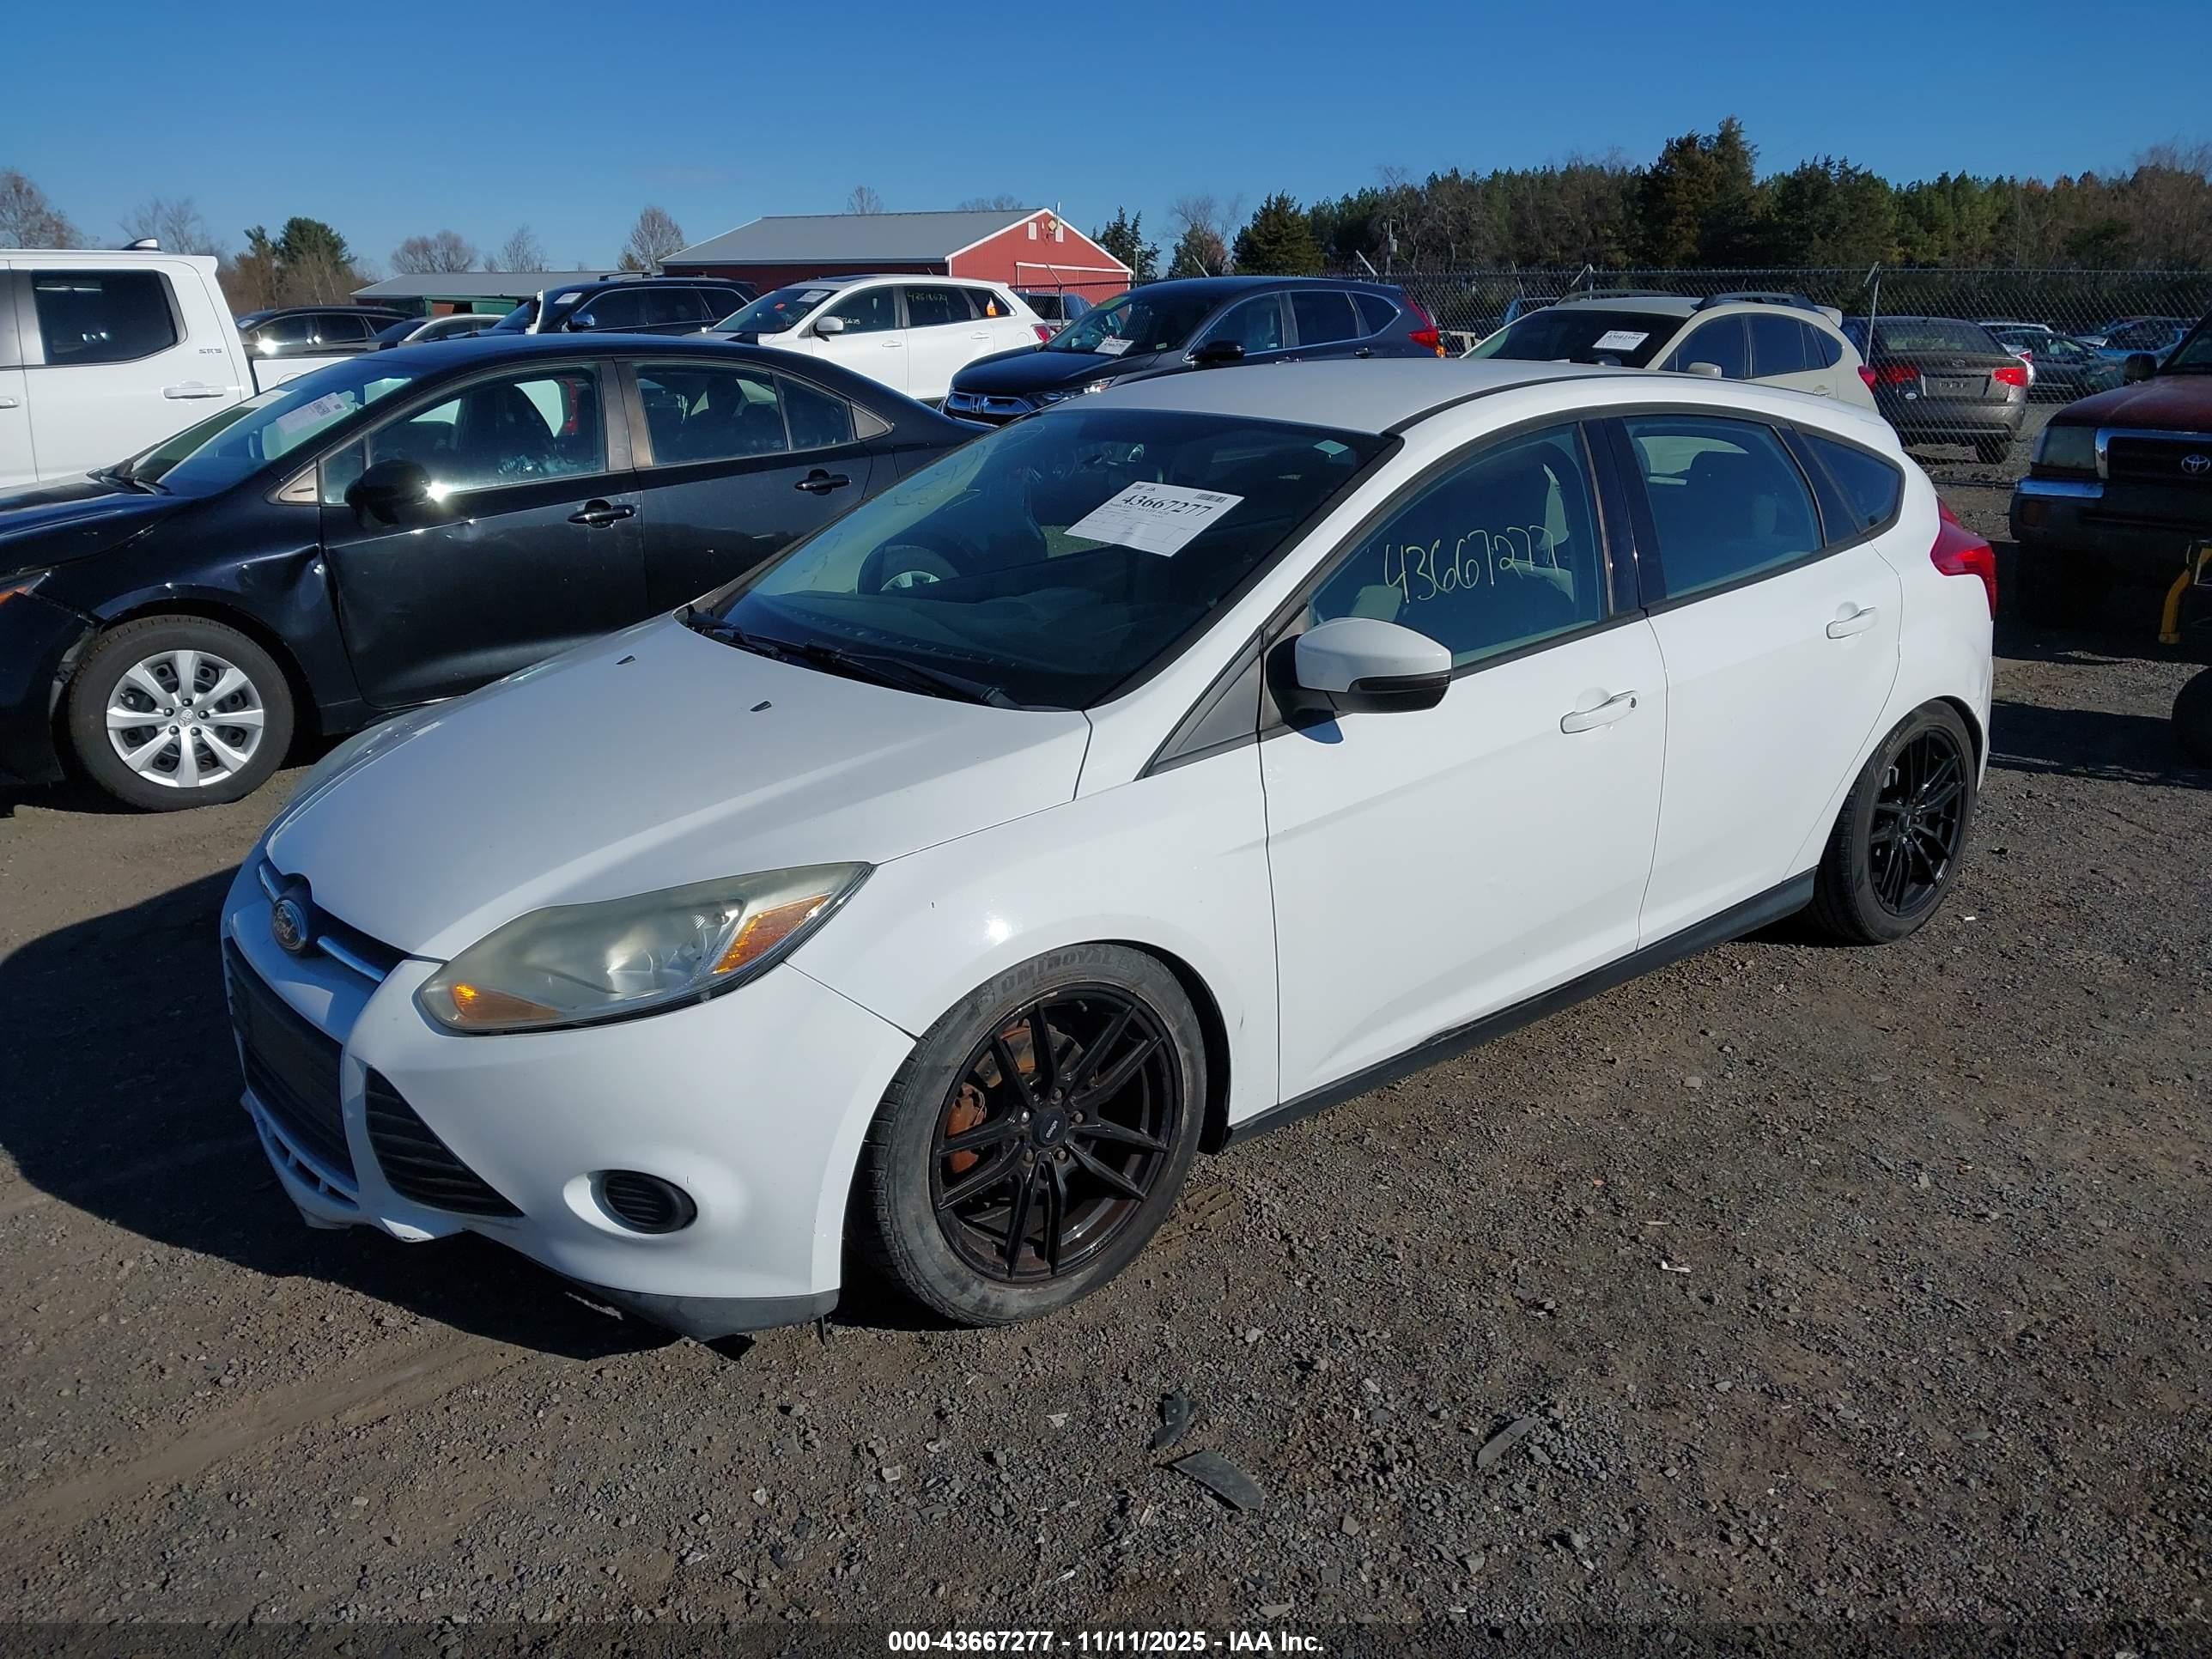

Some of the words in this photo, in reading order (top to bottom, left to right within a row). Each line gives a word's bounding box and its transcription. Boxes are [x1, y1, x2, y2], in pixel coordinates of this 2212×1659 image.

[1121, 494, 1215, 517] 43667277
[1384, 525, 1560, 604] 43667277
[275, 906, 295, 940] Ford
